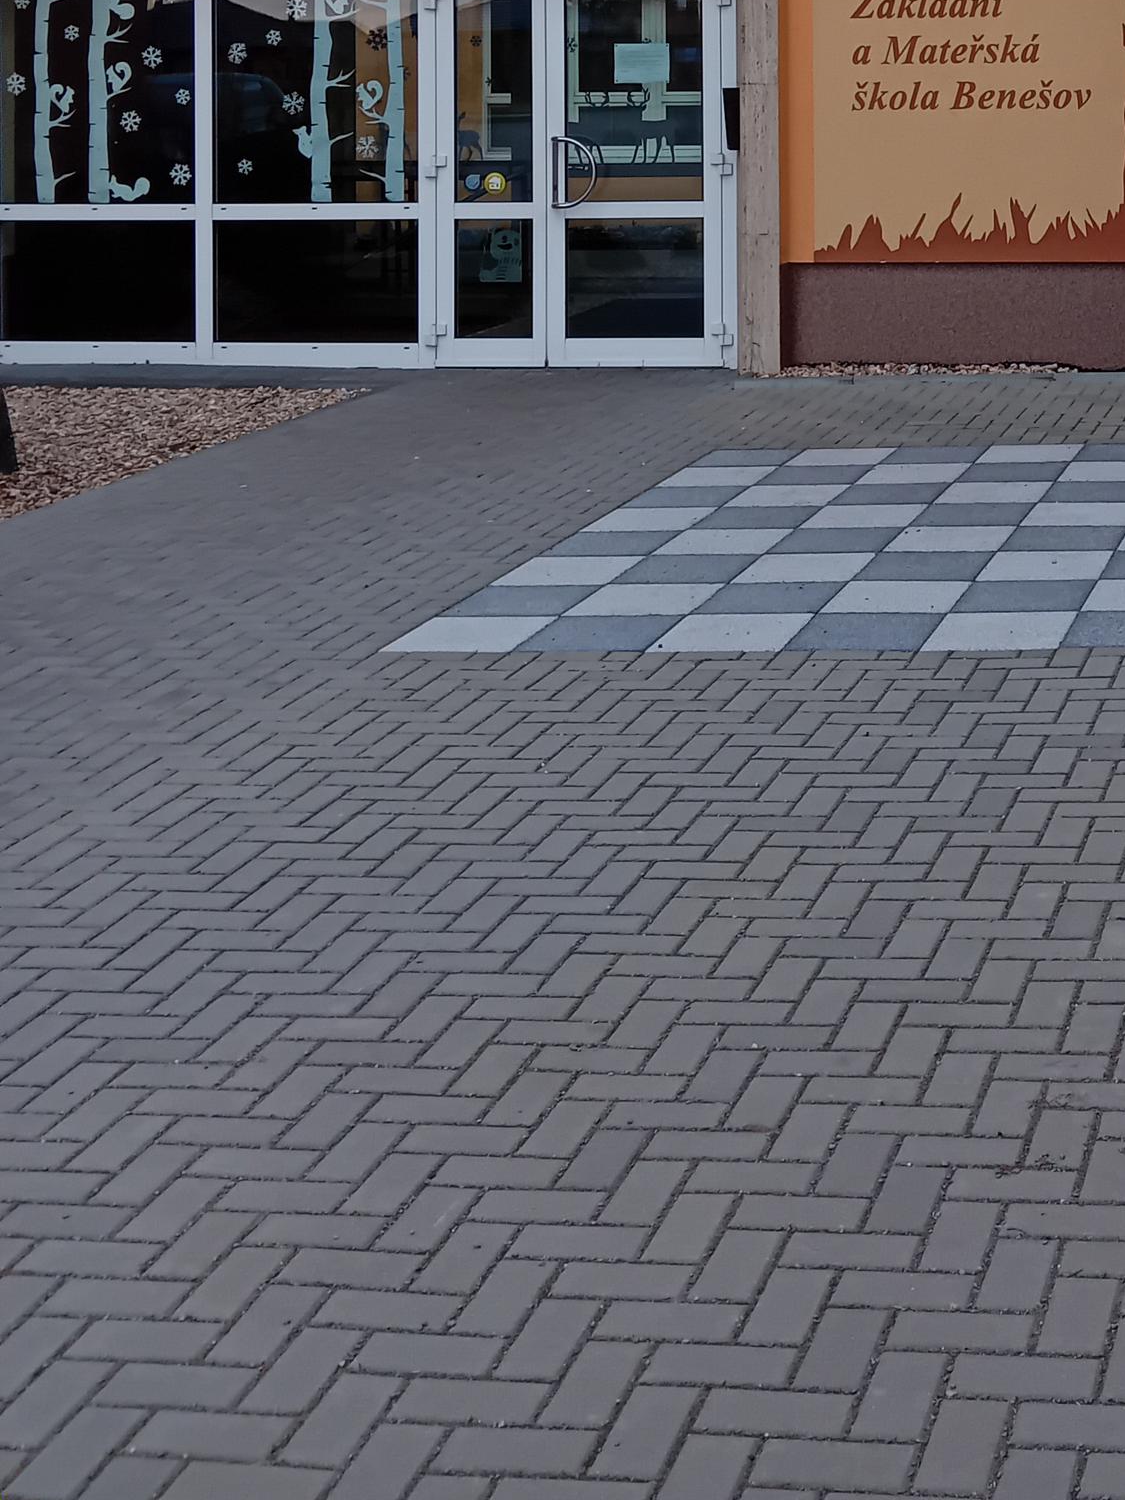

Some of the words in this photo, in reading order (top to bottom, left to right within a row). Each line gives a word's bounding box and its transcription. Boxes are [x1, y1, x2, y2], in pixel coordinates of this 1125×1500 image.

[852, 45, 871, 65] a
[881, 34, 1040, 64] Mateřská
[852, 81, 939, 111] škola
[949, 80, 1092, 110] Benešov
